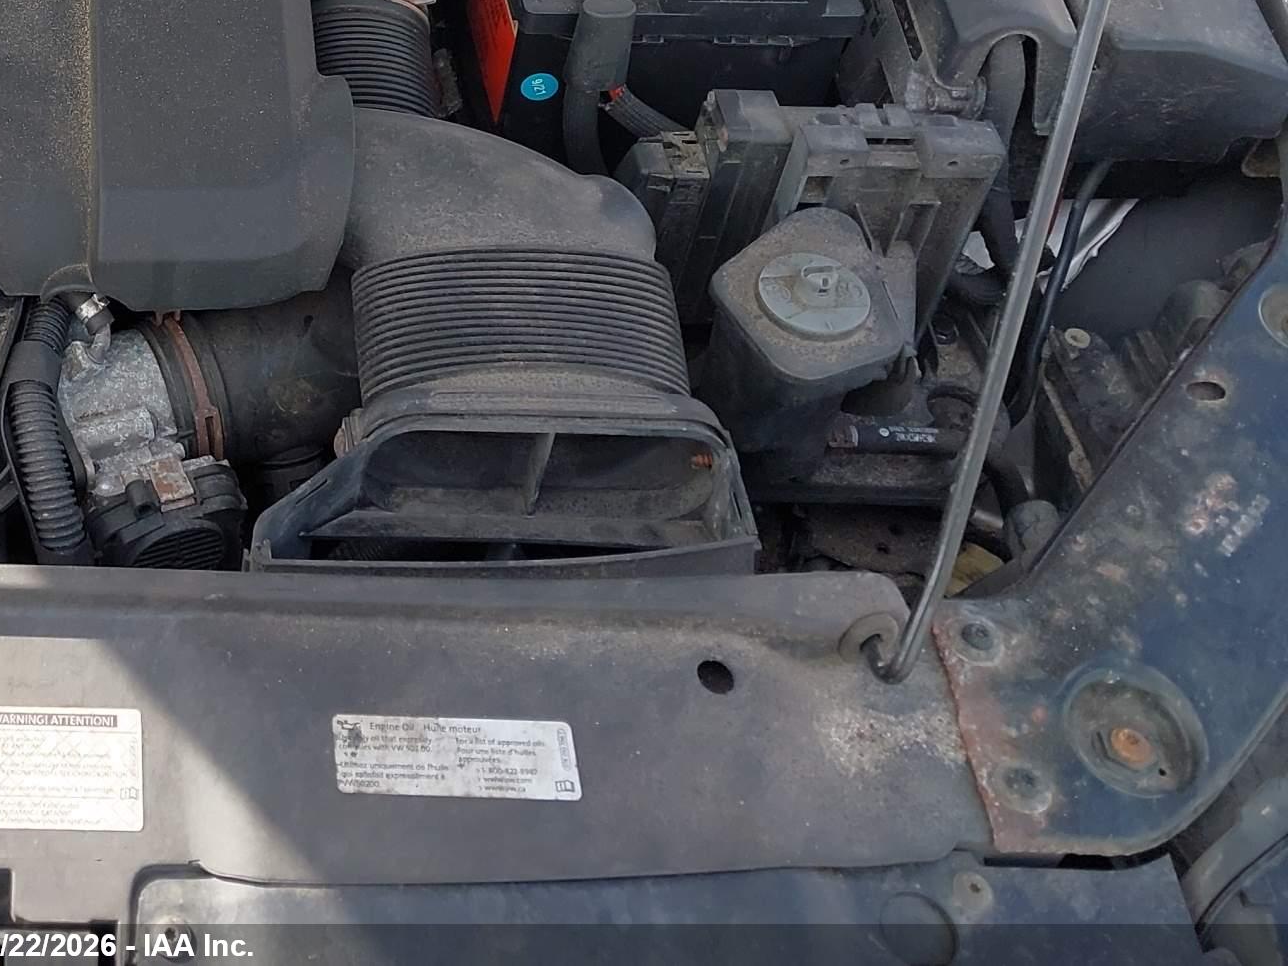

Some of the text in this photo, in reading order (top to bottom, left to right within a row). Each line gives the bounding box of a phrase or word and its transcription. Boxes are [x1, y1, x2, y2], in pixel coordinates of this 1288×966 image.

[50, 715, 114, 727] ATTENTION!
[369, 722, 400, 733] Engine
[402, 723, 415, 731] Oil
[449, 725, 481, 734] moteur
